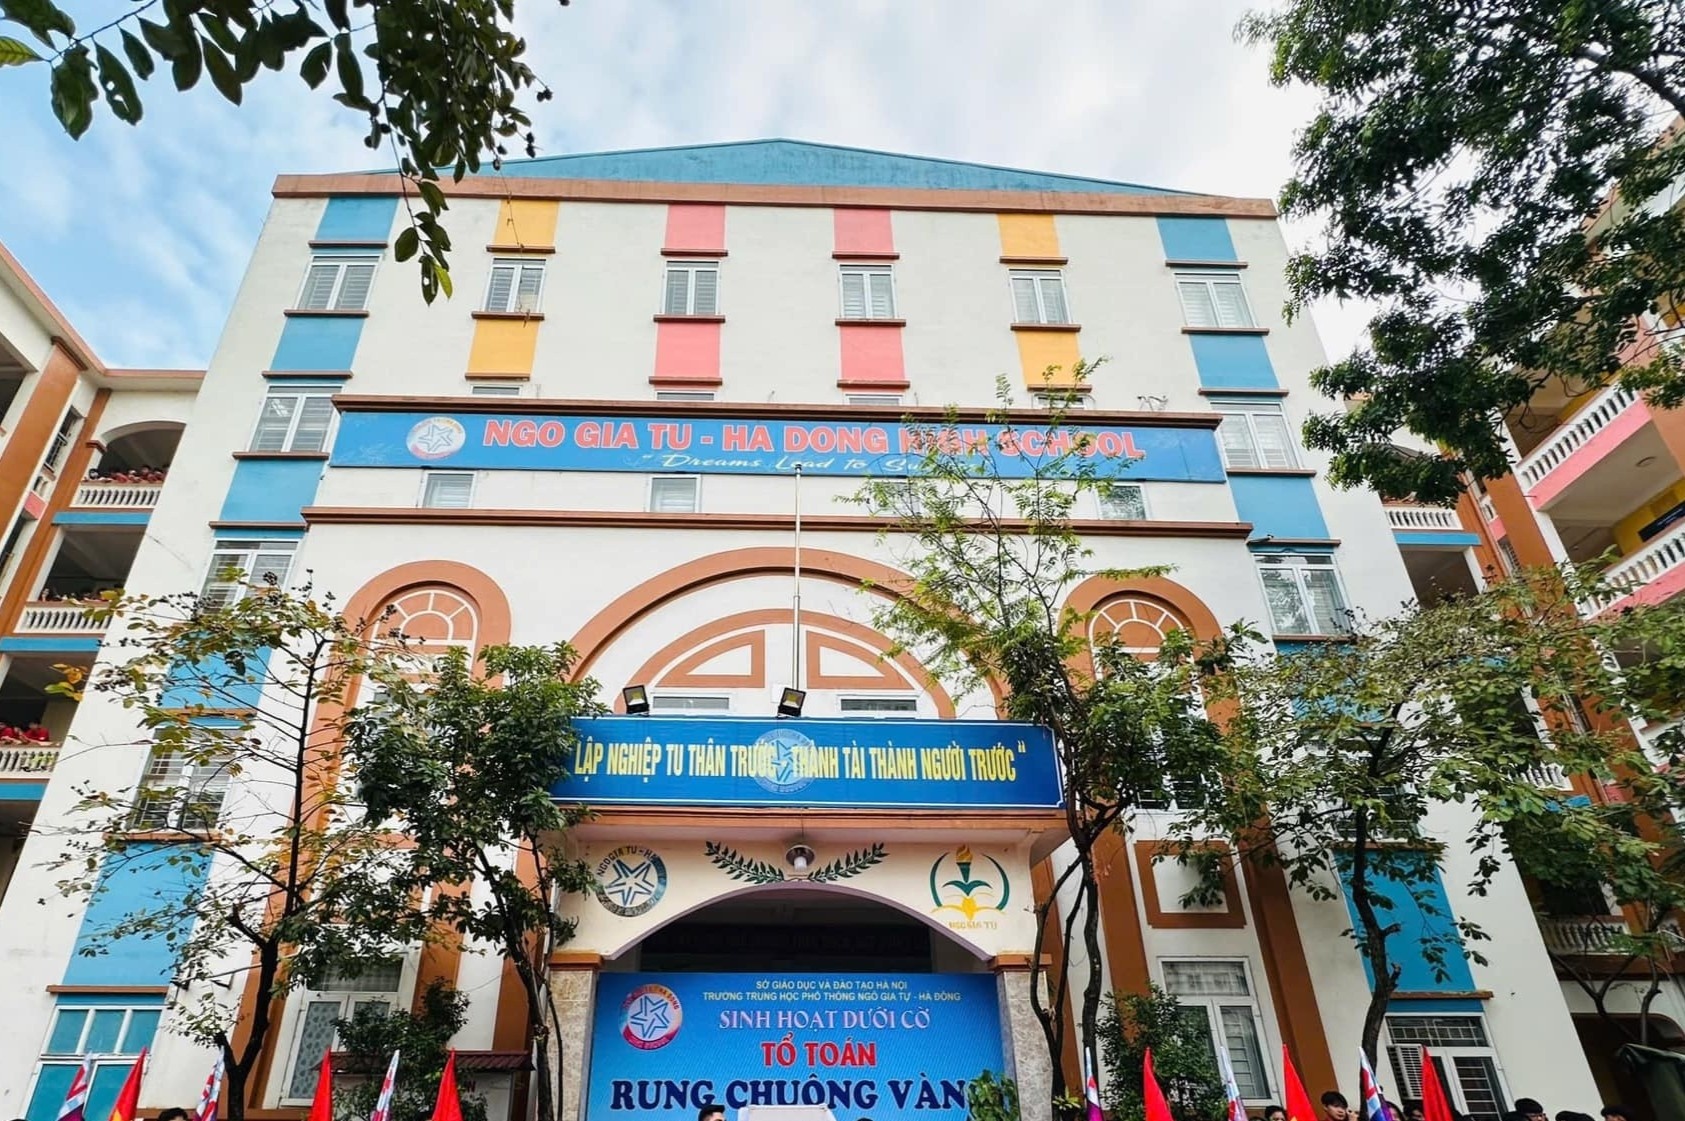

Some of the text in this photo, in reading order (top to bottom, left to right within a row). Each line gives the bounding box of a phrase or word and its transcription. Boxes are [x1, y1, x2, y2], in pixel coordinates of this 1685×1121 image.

[483, 419, 565, 447] NGO
[574, 421, 639, 449] GIA
[647, 422, 693, 451] TU
[700, 434, 714, 444] -
[722, 425, 774, 452] HA
[784, 426, 888, 454] DONG
[997, 429, 1146, 459] SCHOOL
[841, 458, 868, 471] to
[574, 735, 604, 782] LẬP
[606, 736, 662, 783] NGHIỆP
[688, 738, 725, 777] THÂN
[791, 739, 839, 779] THÀNH
[842, 740, 866, 779] TÀI
[868, 740, 918, 780] THÀNH
[920, 741, 966, 781] NGƯỜI
[968, 742, 1016, 782] TRƯỚC
[625, 845, 638, 854] TU
[746, 991, 777, 1001] TRUNG
[880, 991, 897, 1001] GIA
[719, 1006, 931, 1032] SINH HOẠT DƯỚI CỜ
[761, 1031, 878, 1067] TỔ TOÁN
[610, 1072, 975, 1110] RUNG CHUÔNG VÀN
